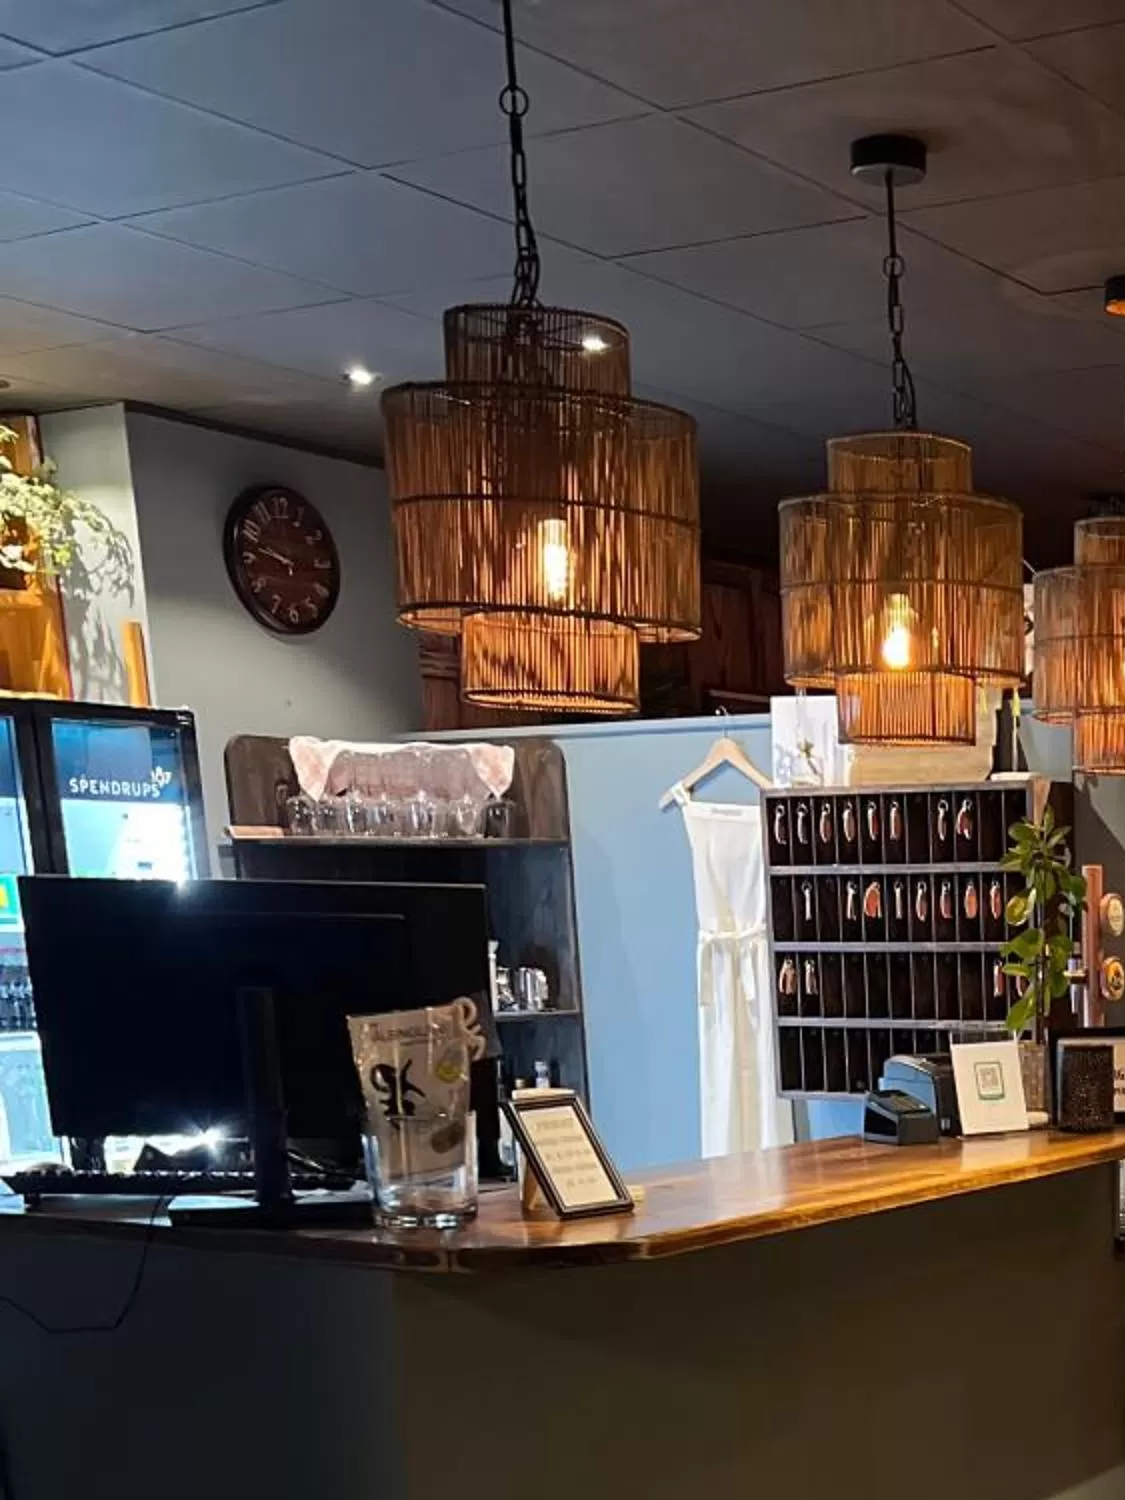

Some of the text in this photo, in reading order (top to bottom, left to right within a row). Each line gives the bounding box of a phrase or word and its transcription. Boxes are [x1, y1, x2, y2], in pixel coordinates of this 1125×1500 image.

[271, 497, 289, 519] 12
[271, 594, 282, 615] 7
[287, 602, 300, 625] 6
[69, 776, 161, 799] SPENDRUPS
